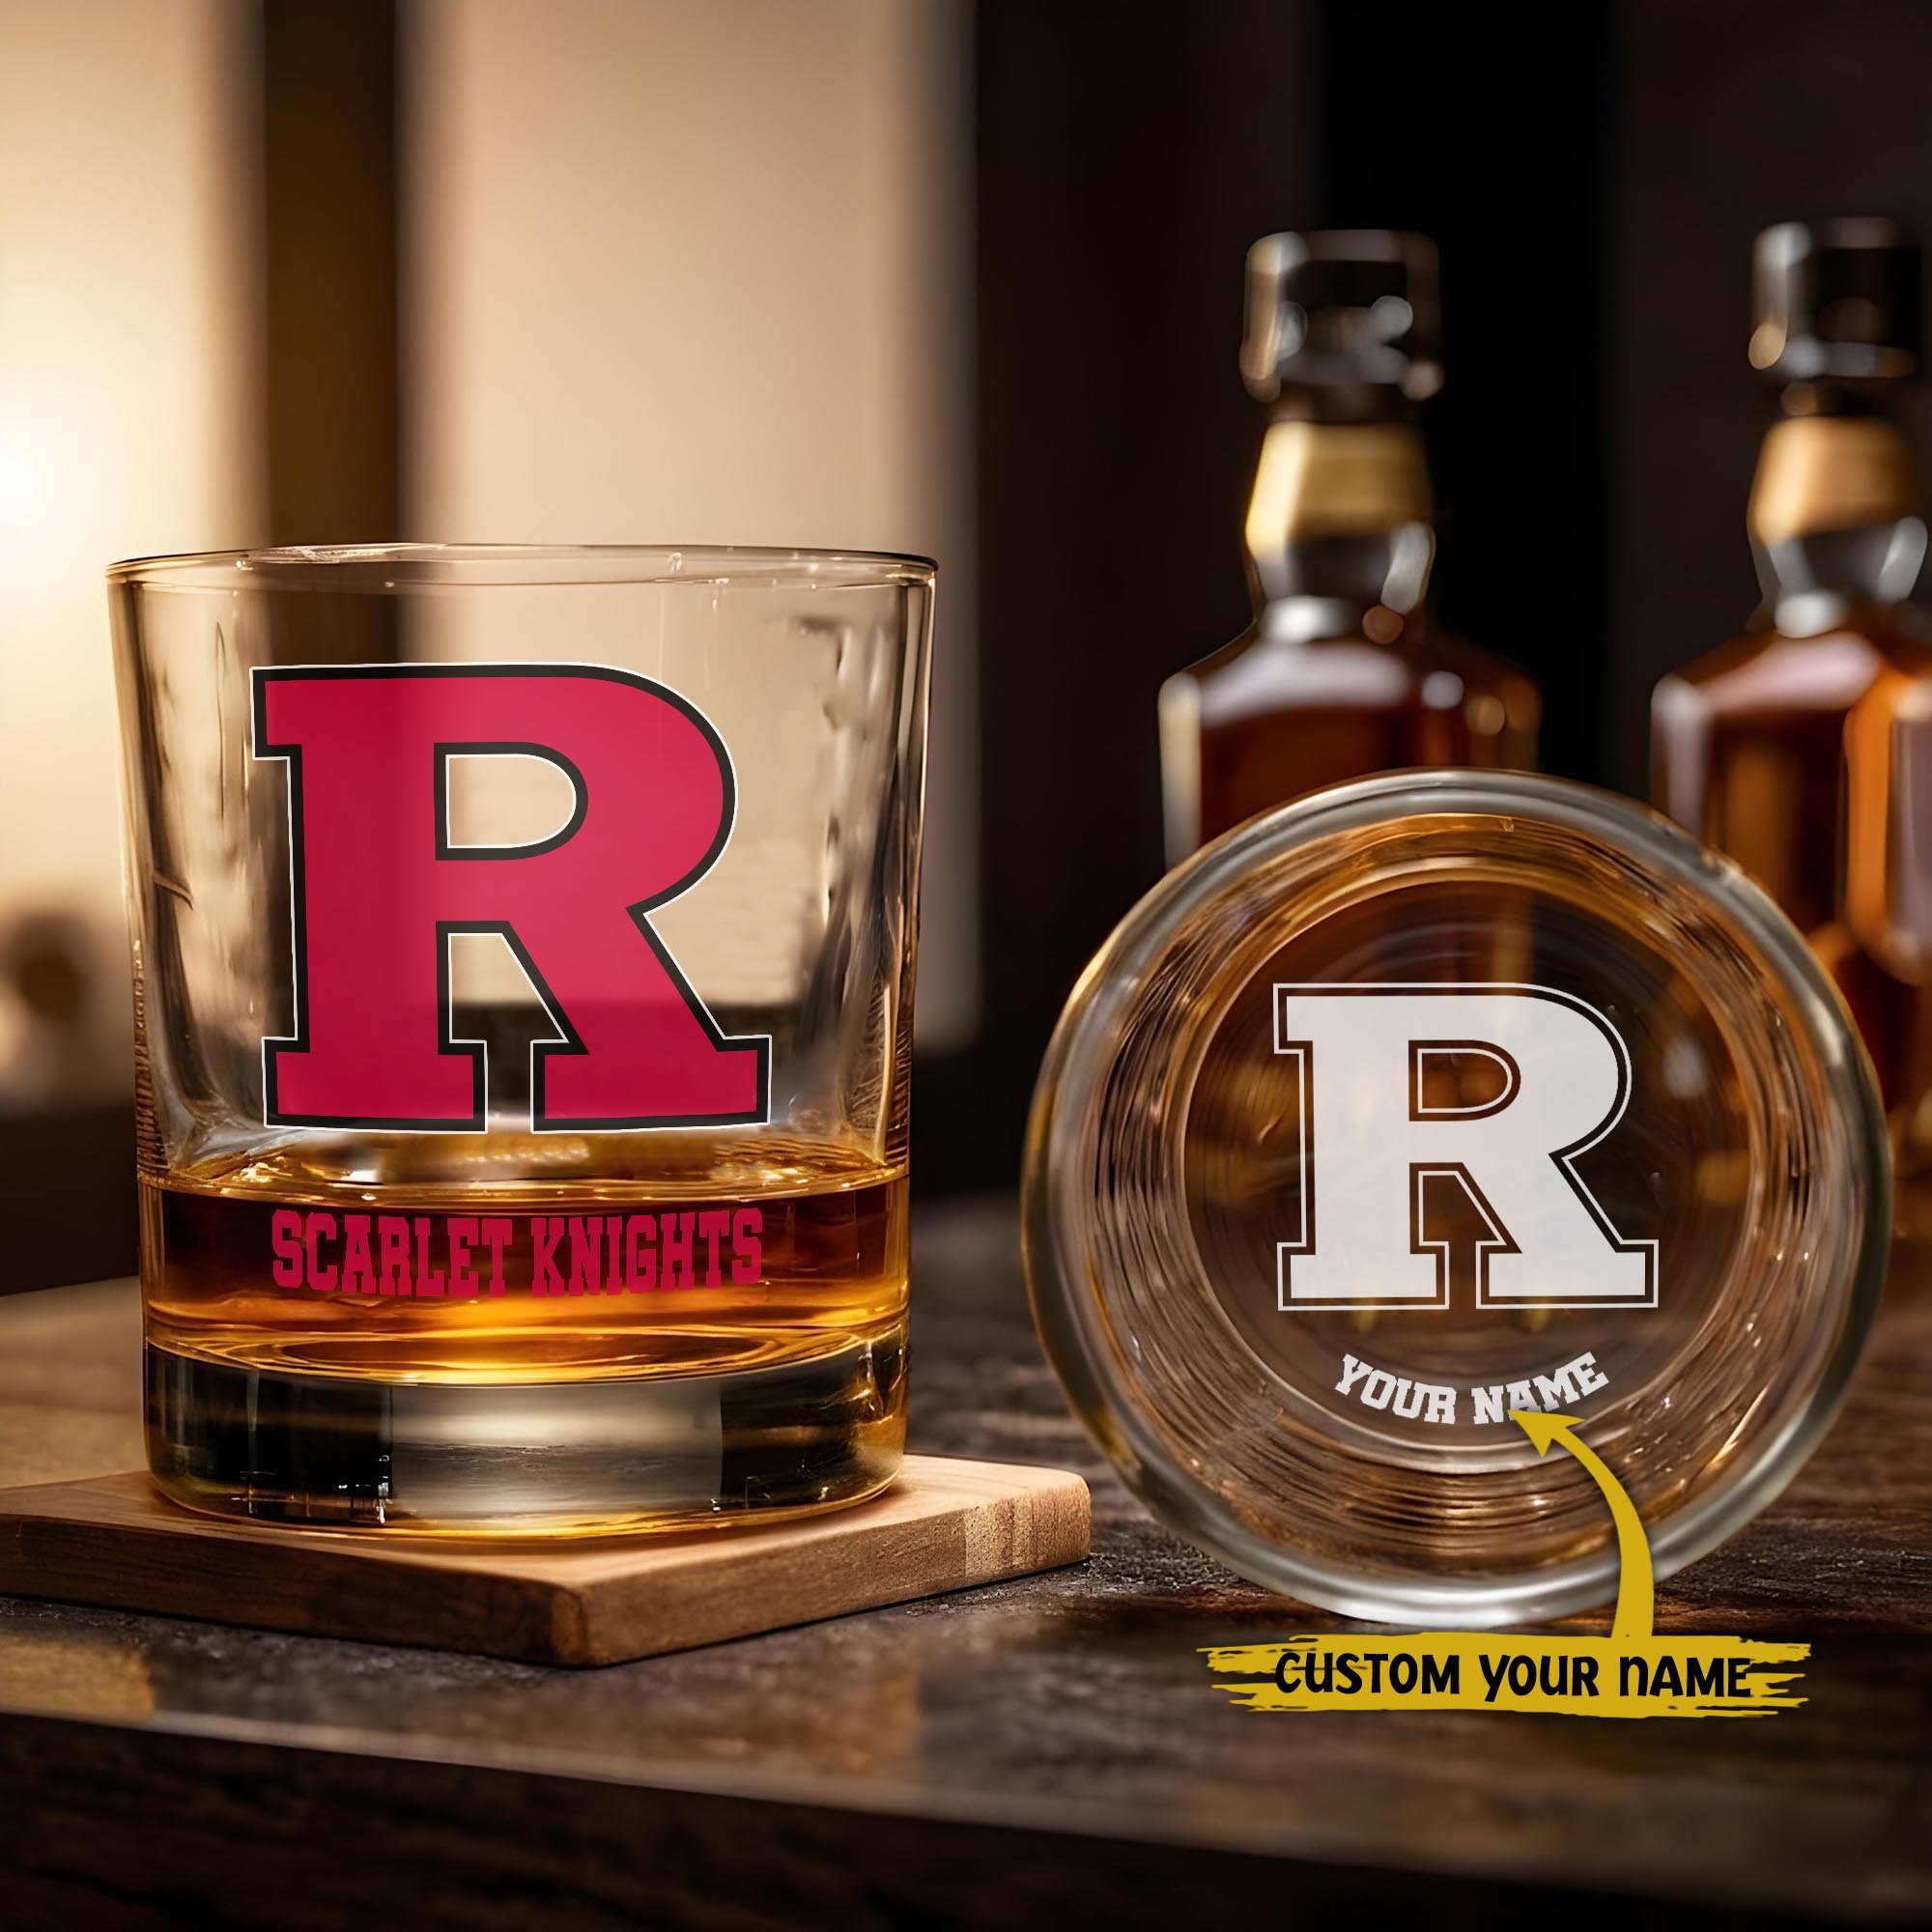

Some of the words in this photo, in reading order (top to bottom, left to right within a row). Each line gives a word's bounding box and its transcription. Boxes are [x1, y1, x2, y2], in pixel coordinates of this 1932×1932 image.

[249, 662, 772, 1134] R
[1272, 982, 1659, 1311] R
[272, 1209, 512, 1297] SCARLET
[531, 1208, 763, 1297] KNIGHTS
[1335, 1353, 1458, 1425] YOUR
[1471, 1351, 1609, 1425] NAME
